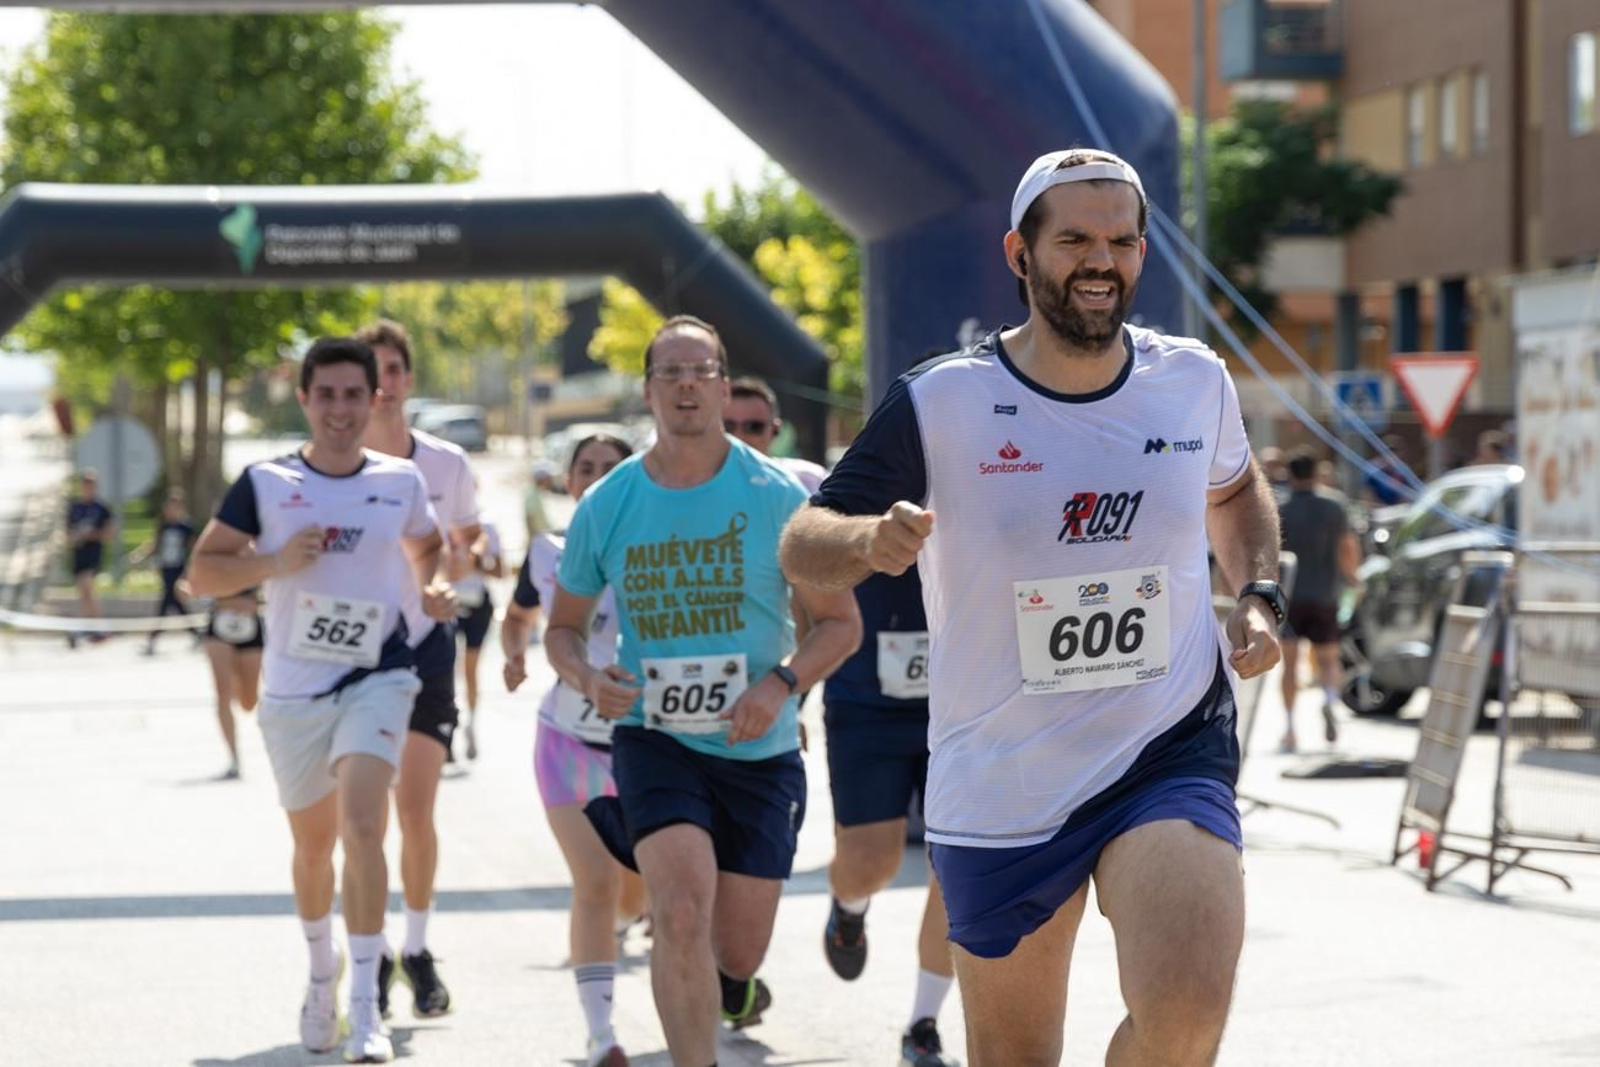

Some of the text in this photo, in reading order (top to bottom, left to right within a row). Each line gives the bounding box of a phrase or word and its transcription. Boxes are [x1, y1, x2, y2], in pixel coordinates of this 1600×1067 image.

[979, 461, 1044, 474] Santander
[625, 533, 744, 571] MUÉVETE
[623, 567, 745, 592] CON A.L.E.S
[627, 589, 745, 612] POR EL CÁNCER
[307, 617, 367, 647] 562
[1049, 607, 1146, 661] 606
[907, 655, 928, 680] 6
[1054, 659, 1145, 677] ALBERTO NAVARRO SÁNCHEZ
[661, 682, 728, 714] 605
